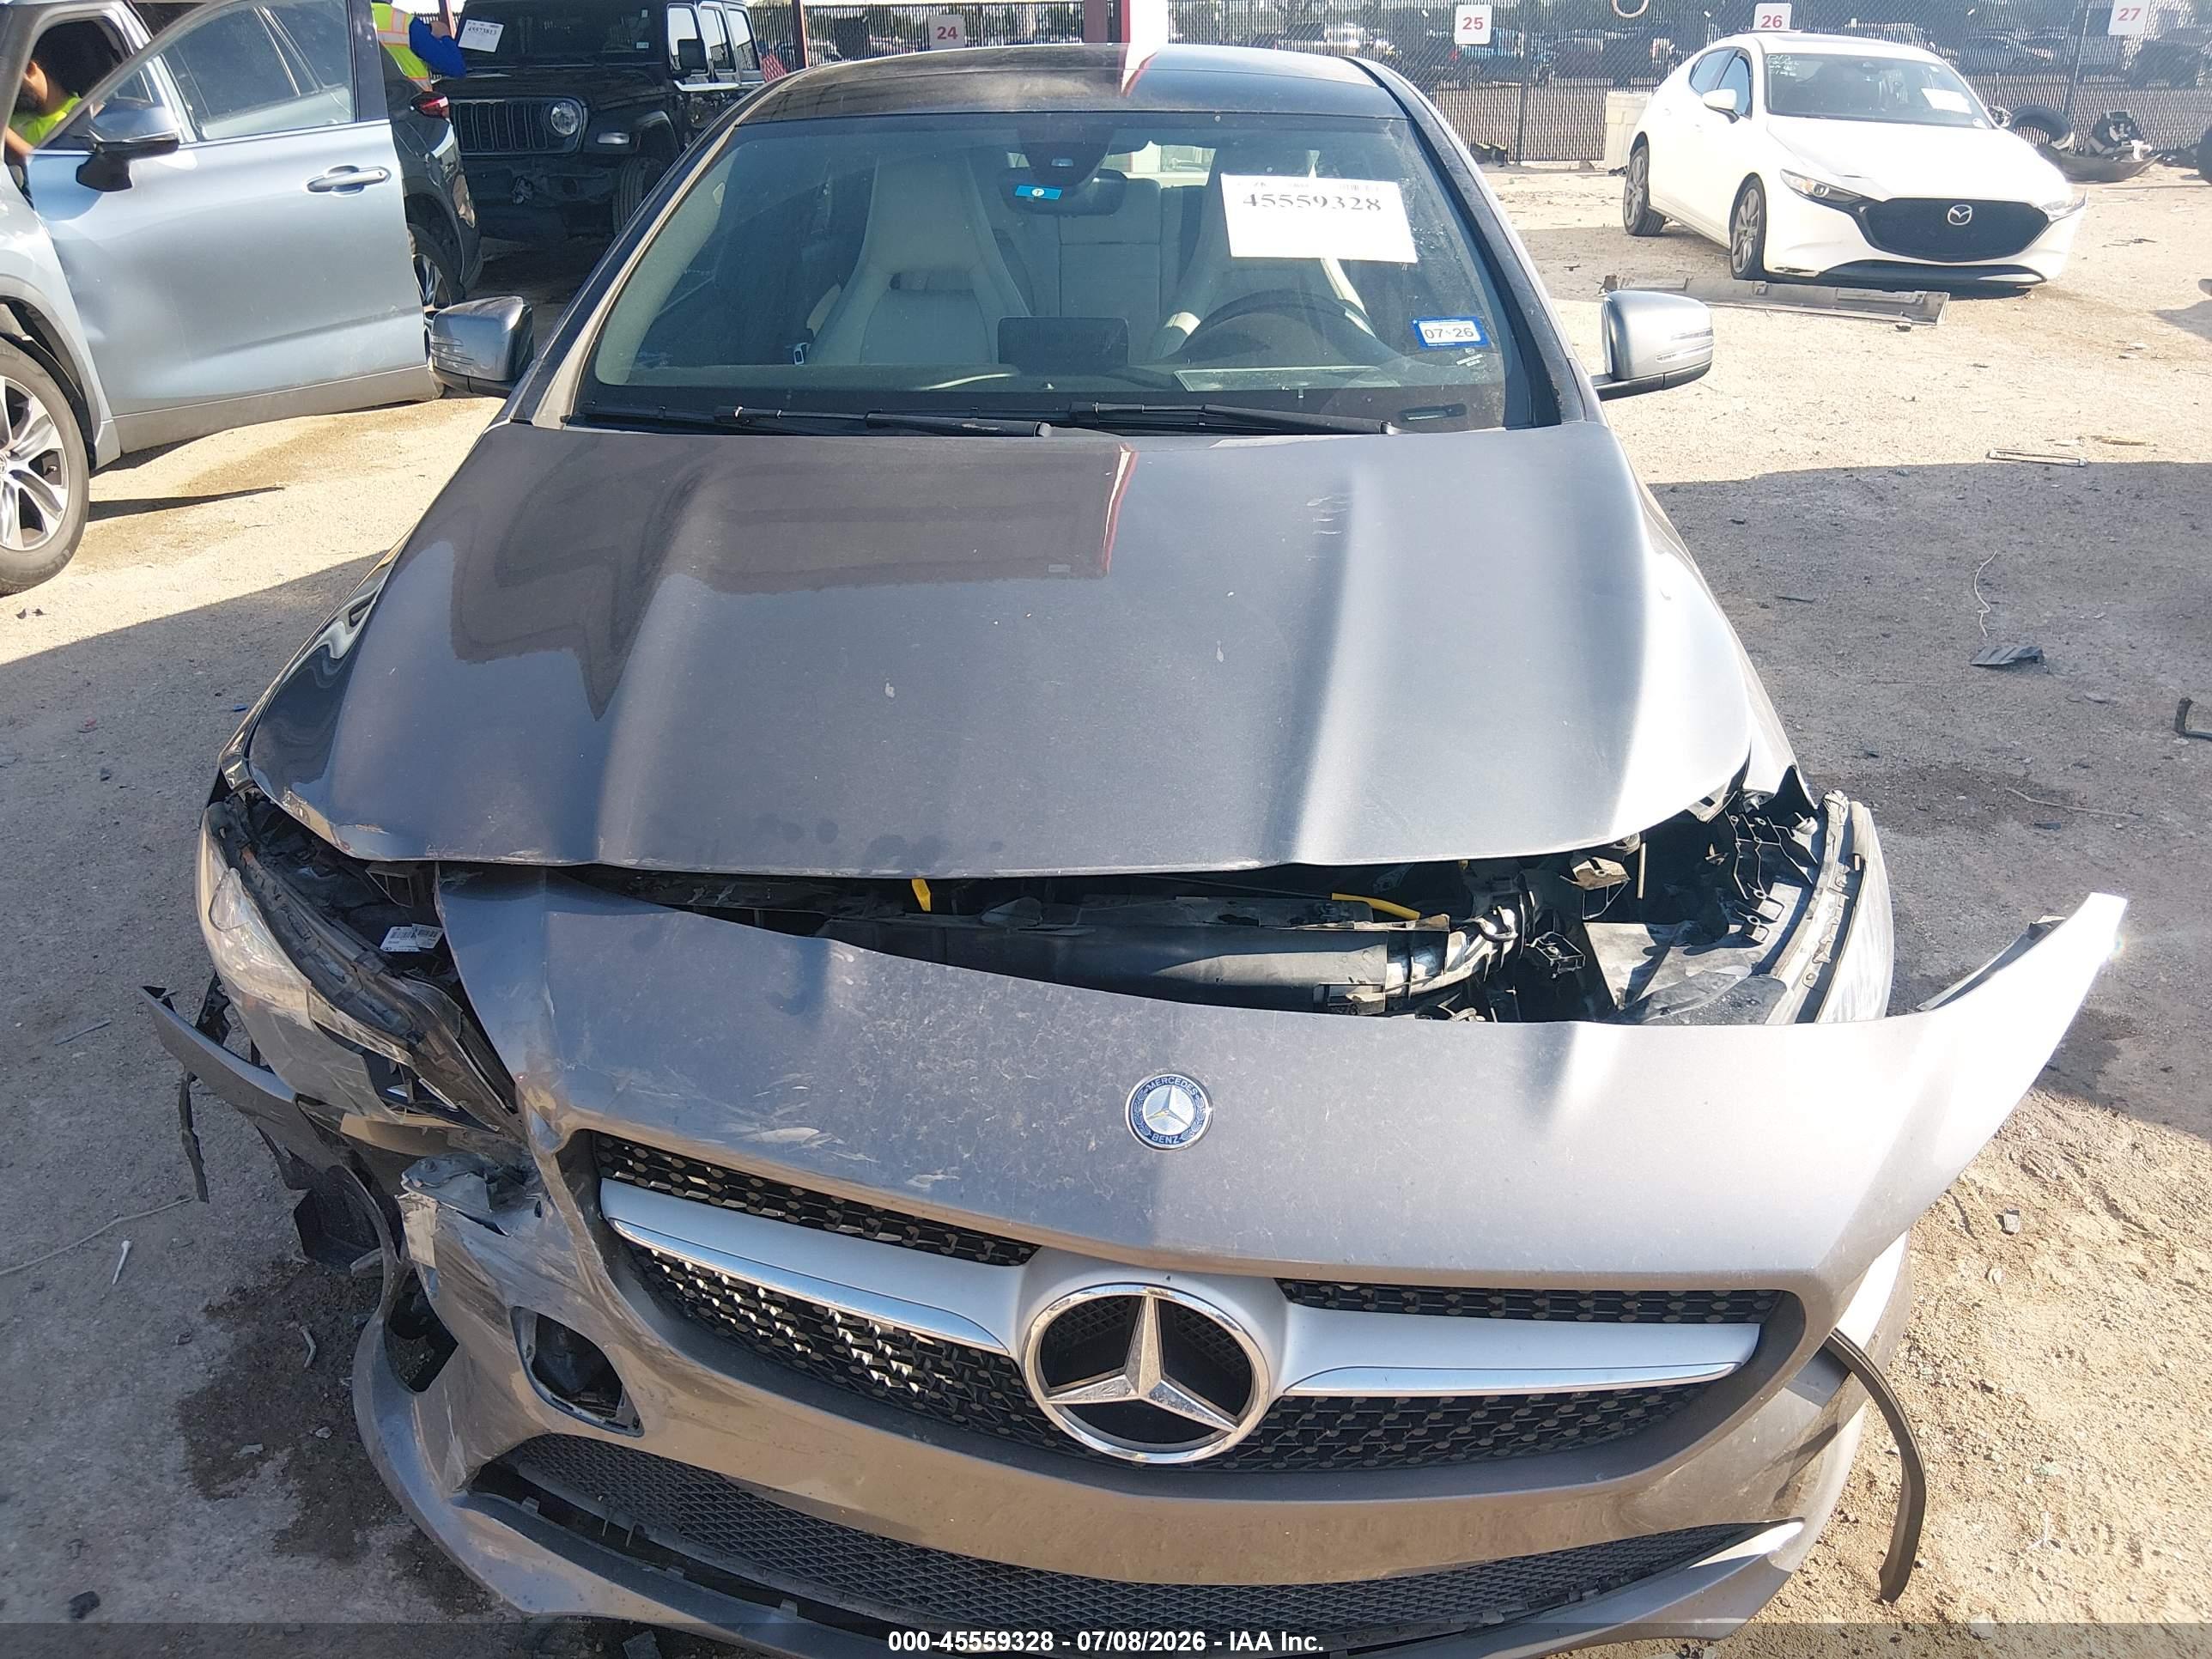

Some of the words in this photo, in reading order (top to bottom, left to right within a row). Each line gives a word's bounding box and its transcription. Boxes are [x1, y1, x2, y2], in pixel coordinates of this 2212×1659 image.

[2117, 8, 2142, 21] 27
[1462, 16, 1484, 30] 25
[1760, 15, 1783, 28] 26
[937, 26, 958, 40] 24
[1243, 193, 1382, 212] 45559328
[1424, 328, 1443, 339] 07
[1452, 327, 1474, 337] 26
[1146, 1077, 1198, 1096] MERCEDES
[1151, 1133, 1180, 1144] BENZ
